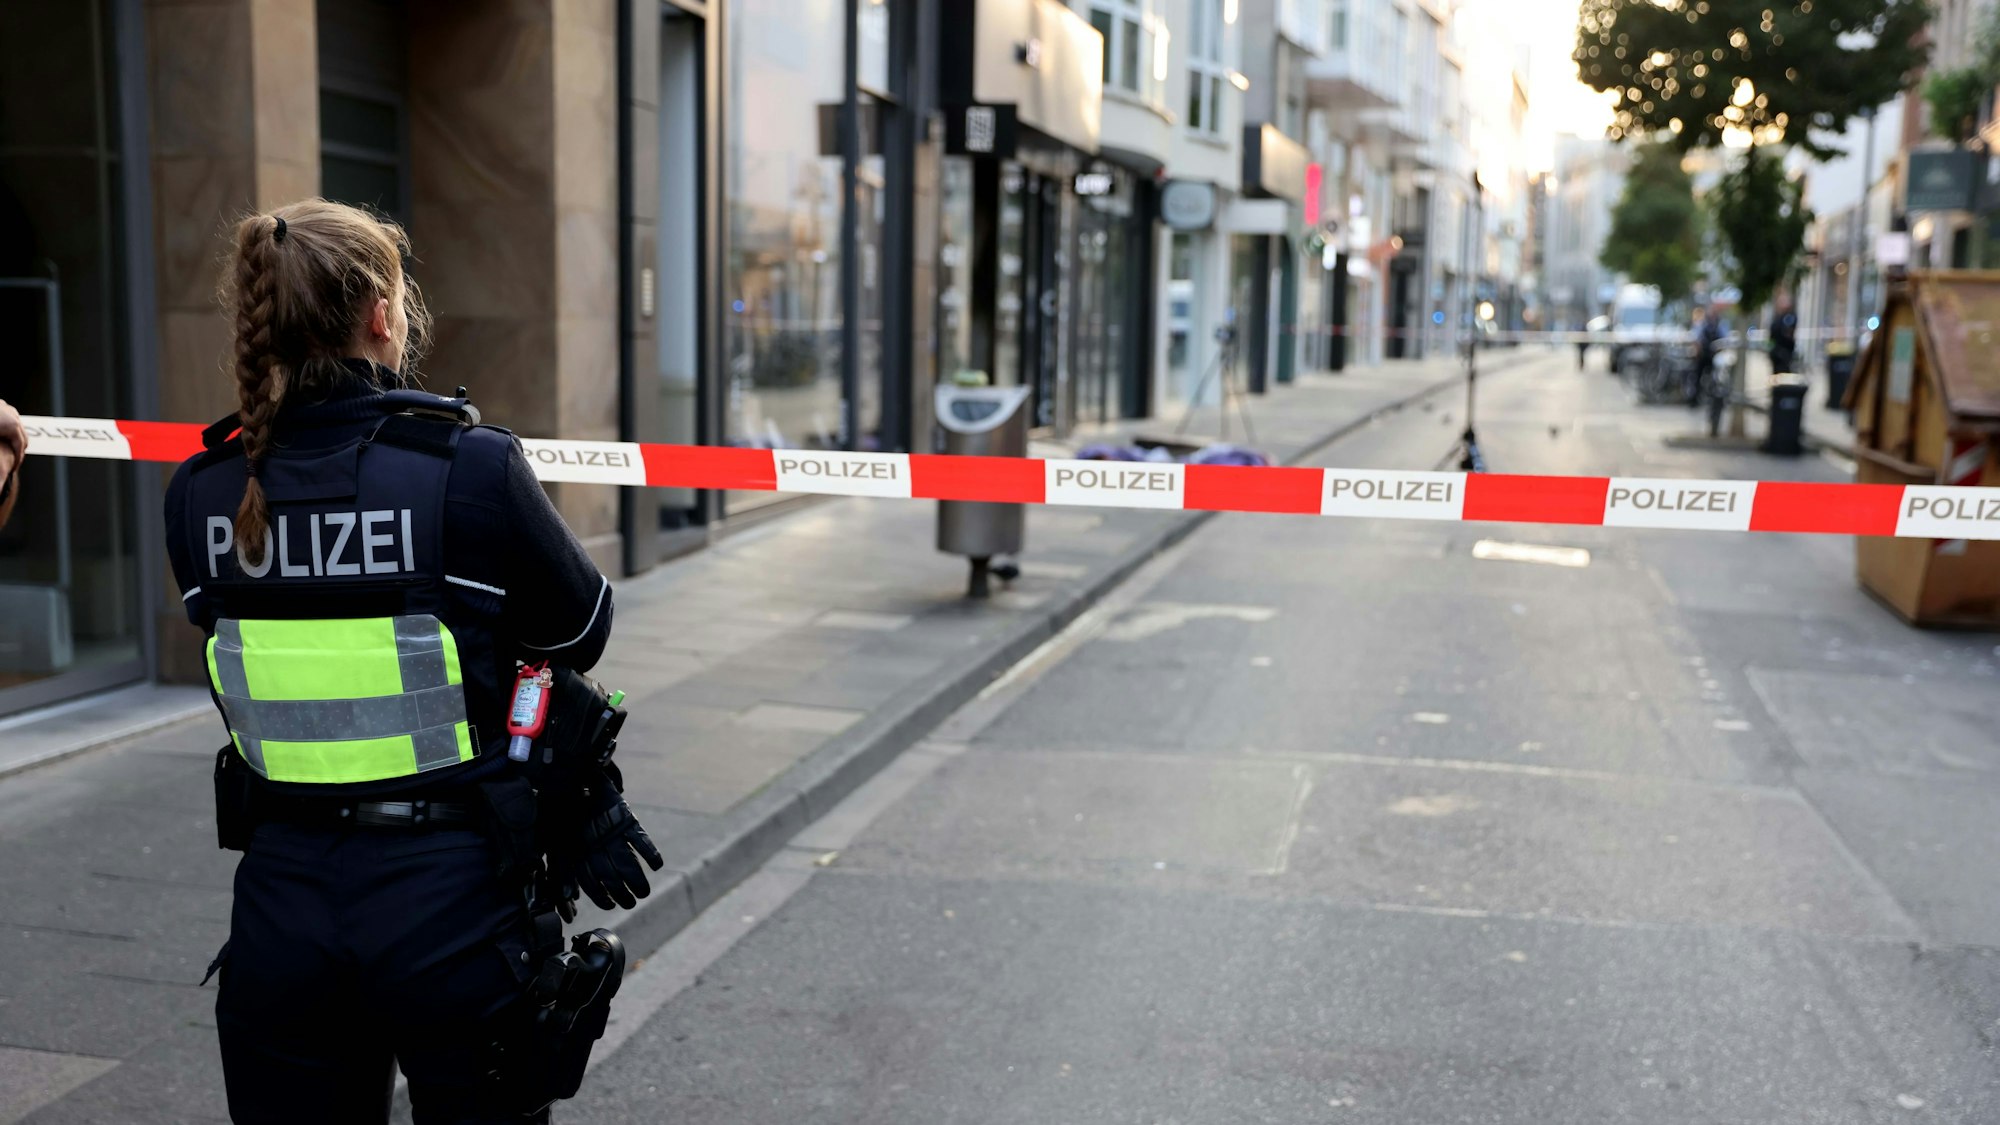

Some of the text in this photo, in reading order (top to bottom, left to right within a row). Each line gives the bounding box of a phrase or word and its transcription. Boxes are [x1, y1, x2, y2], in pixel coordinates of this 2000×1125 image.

[24, 426, 114, 441] OLIZEI
[780, 459, 897, 480] POLIZEI
[1056, 469, 1174, 491] POLIZEI
[1332, 479, 1453, 502] POLIZEI
[1610, 488, 1737, 512] POLIZEI
[206, 508, 415, 578] POLIZEI
